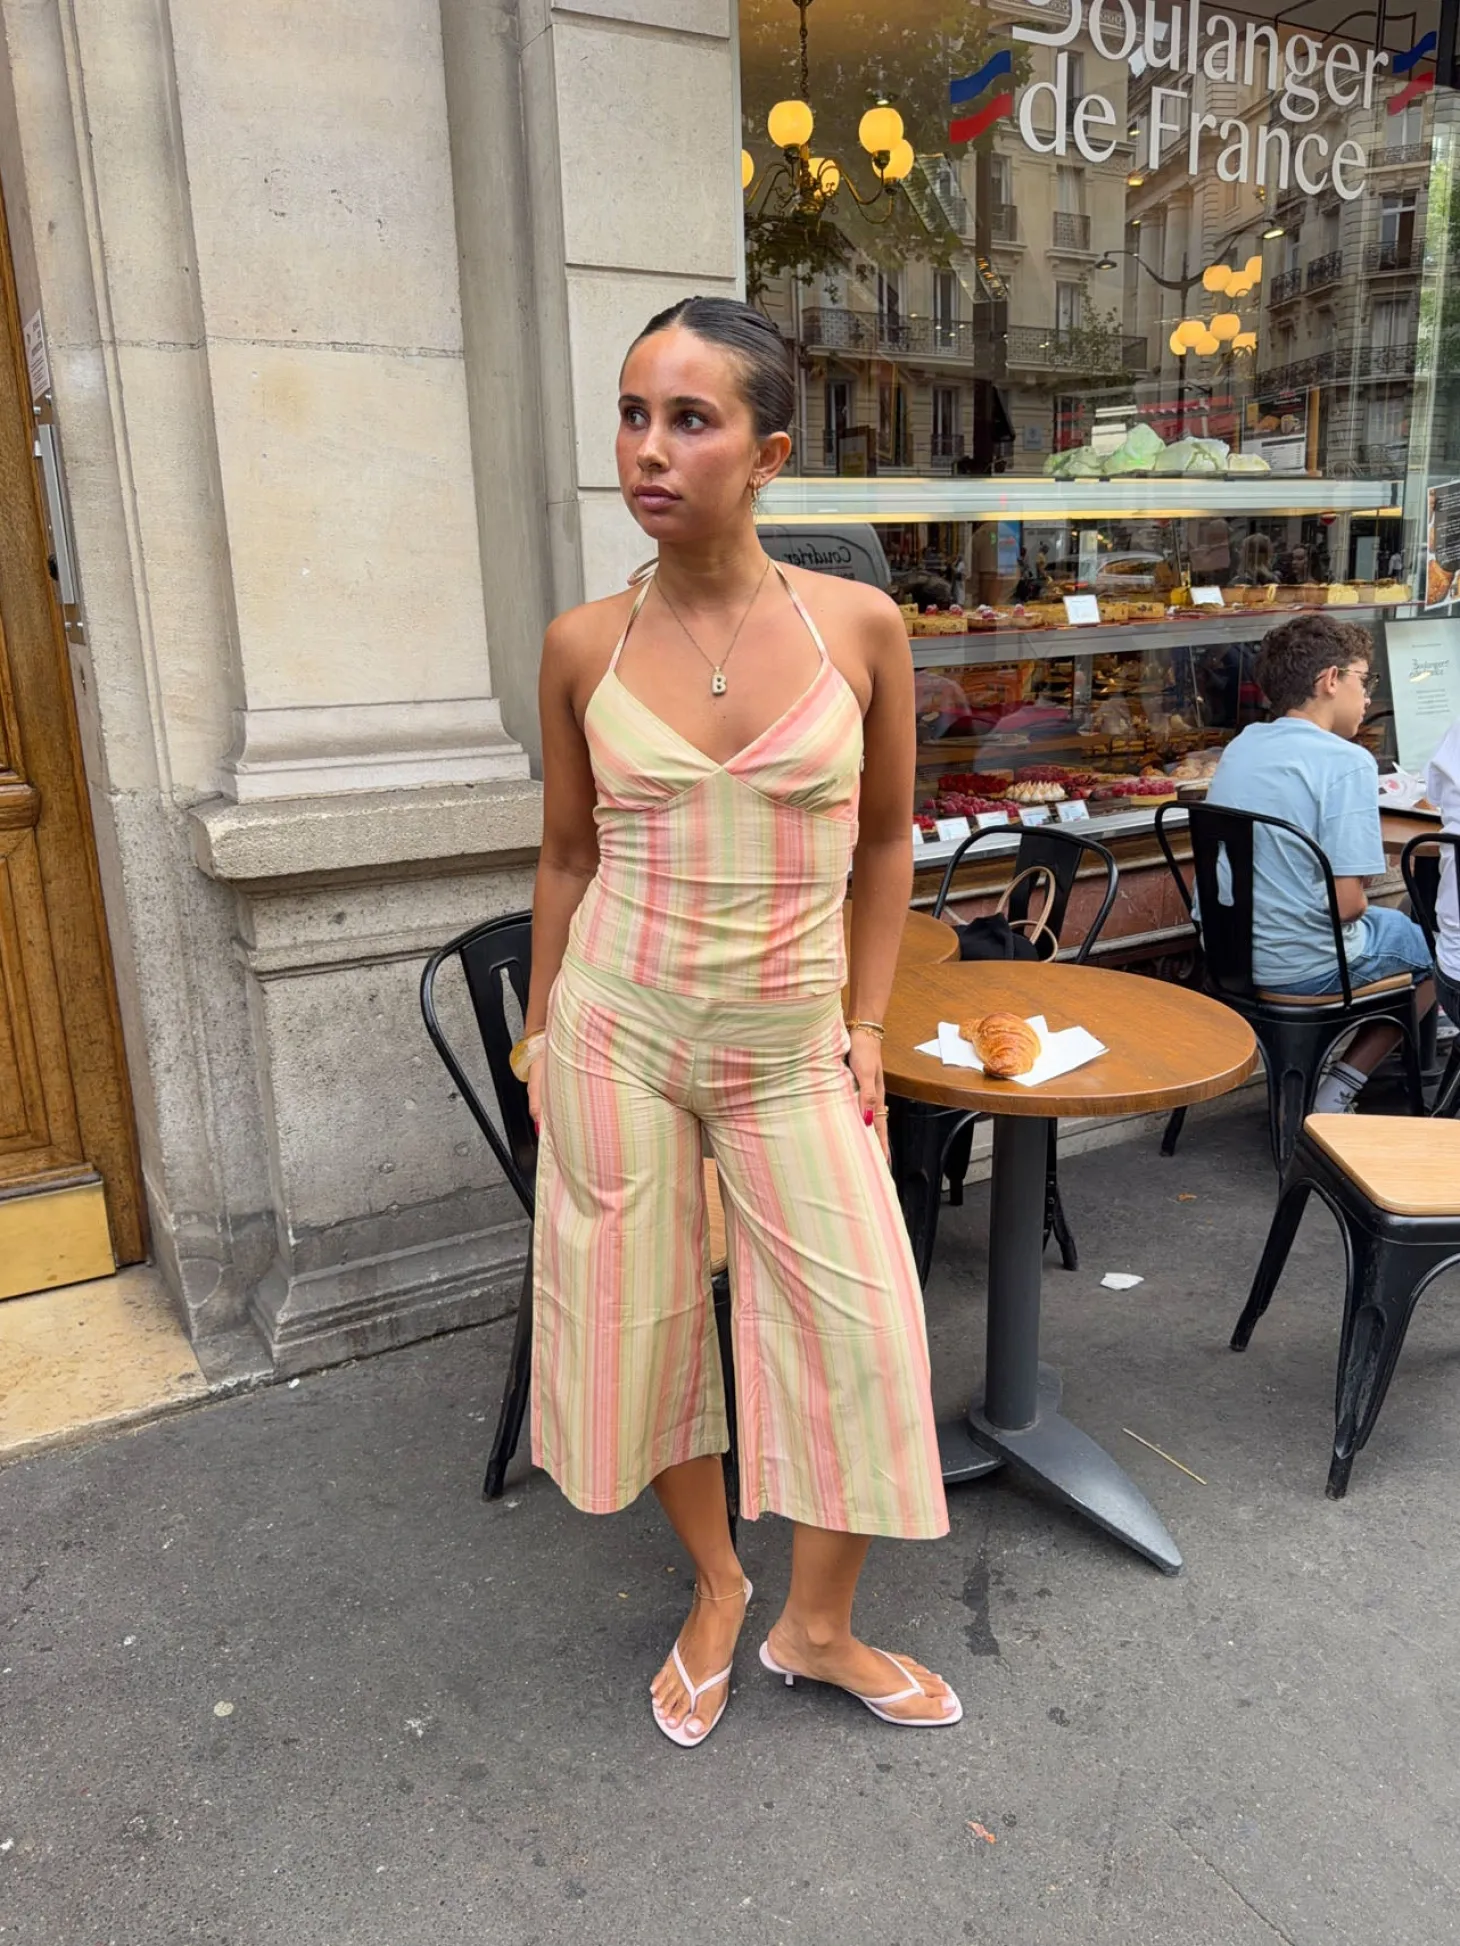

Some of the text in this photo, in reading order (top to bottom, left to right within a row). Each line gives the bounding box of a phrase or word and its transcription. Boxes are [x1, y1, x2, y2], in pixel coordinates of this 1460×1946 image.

[1019, 52, 1367, 200] de France
[712, 674, 727, 695] B
